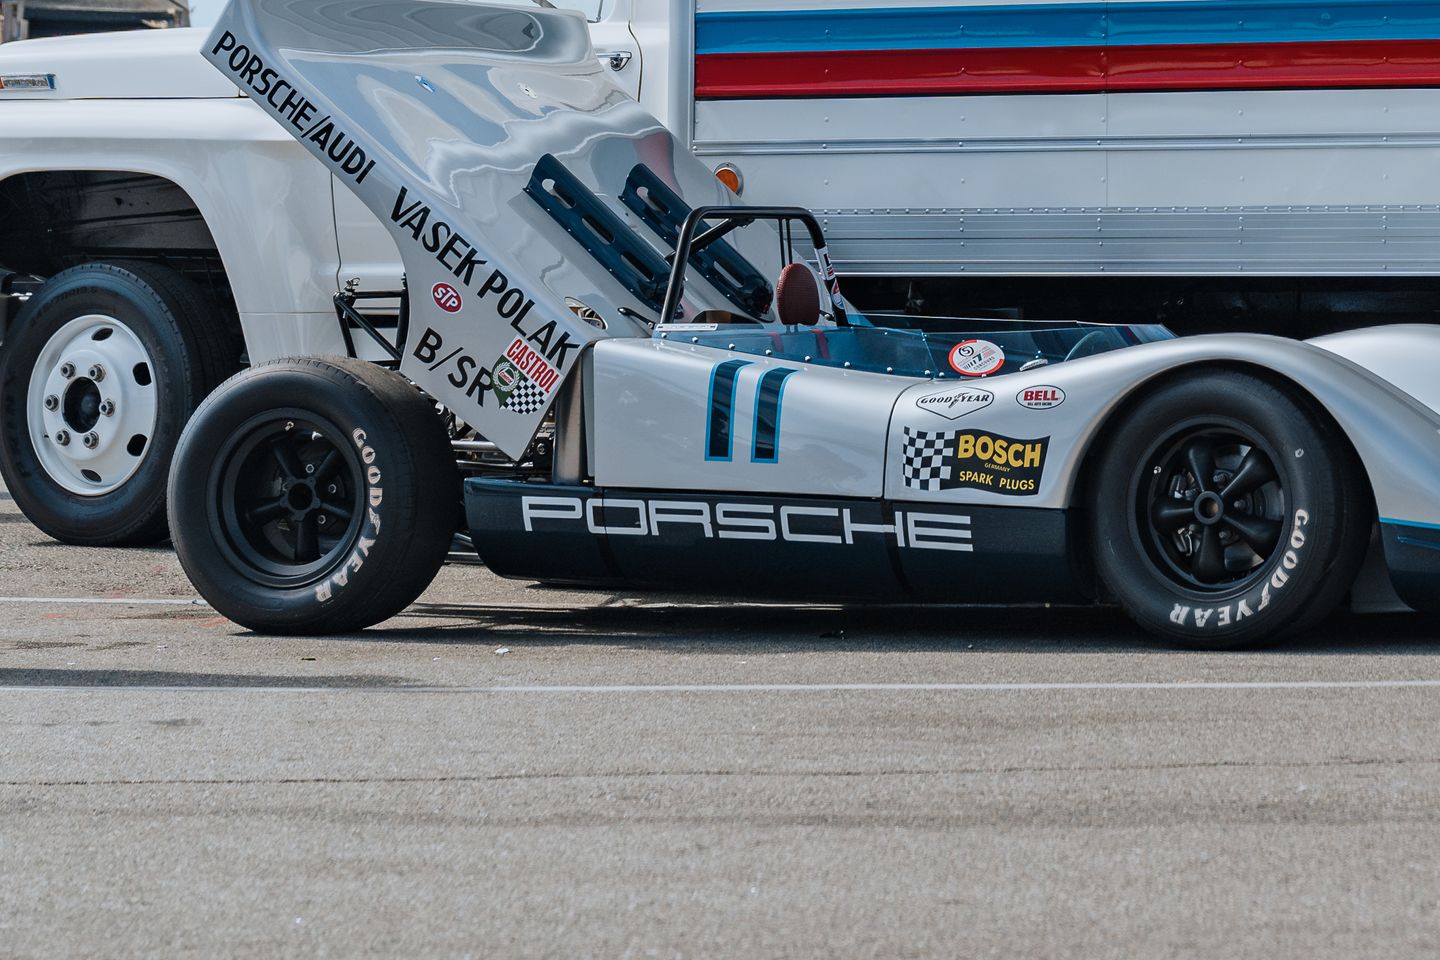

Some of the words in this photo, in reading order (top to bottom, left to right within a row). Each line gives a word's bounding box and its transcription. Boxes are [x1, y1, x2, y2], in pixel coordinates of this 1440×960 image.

[211, 30, 378, 185] PORSCHE/AUDI
[390, 185, 488, 287] VASEK
[476, 268, 581, 371] POLAK
[433, 286, 459, 309] STP
[411, 326, 495, 408] B/SR
[506, 338, 560, 394] CASTROL
[704, 359, 799, 464] 11
[1023, 390, 1059, 401] BELL
[957, 434, 1042, 468] BOSCH
[984, 462, 1011, 473] GERMANY
[959, 471, 994, 486] SPARK
[998, 477, 1035, 491] PLUGS
[521, 495, 974, 552] PORSCHE
